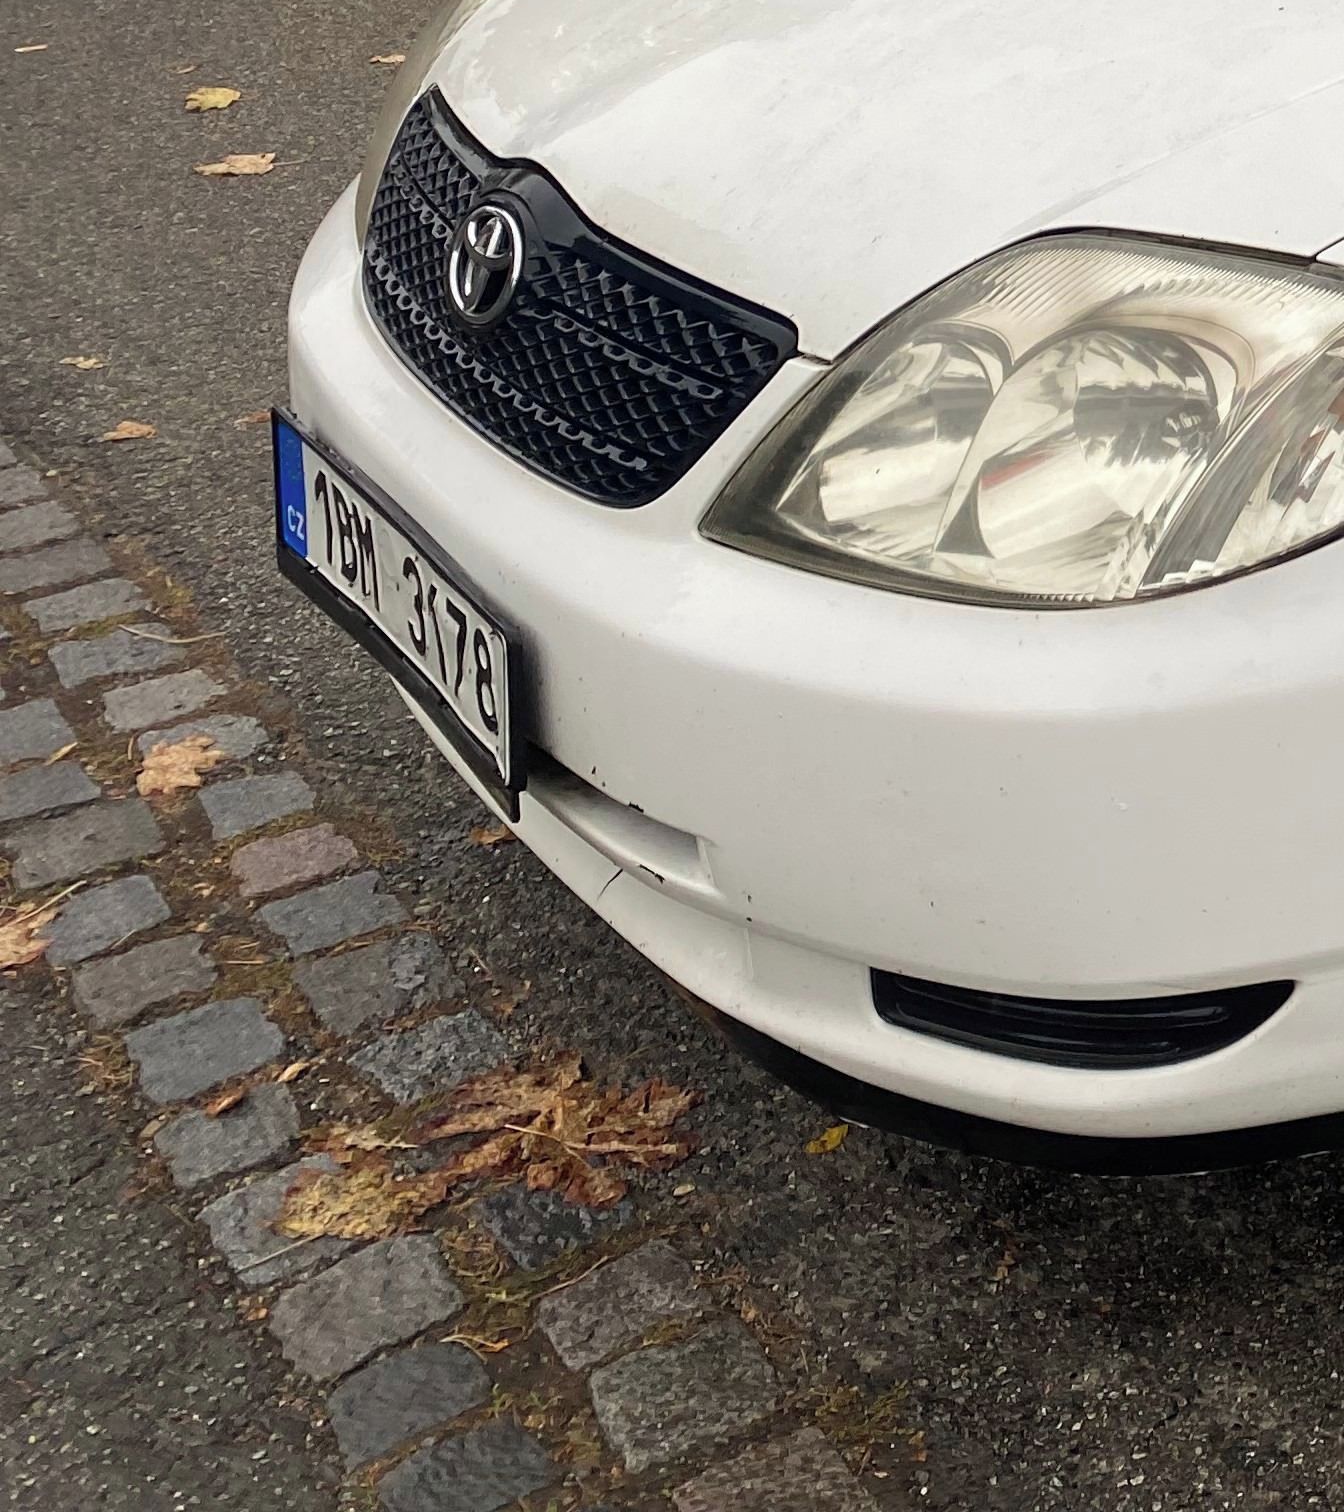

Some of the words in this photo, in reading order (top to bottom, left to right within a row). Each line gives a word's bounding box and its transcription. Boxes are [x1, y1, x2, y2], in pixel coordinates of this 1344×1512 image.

[287, 504, 305, 541] CZ
[314, 469, 380, 613] 1BM
[402, 555, 499, 735] 3178
